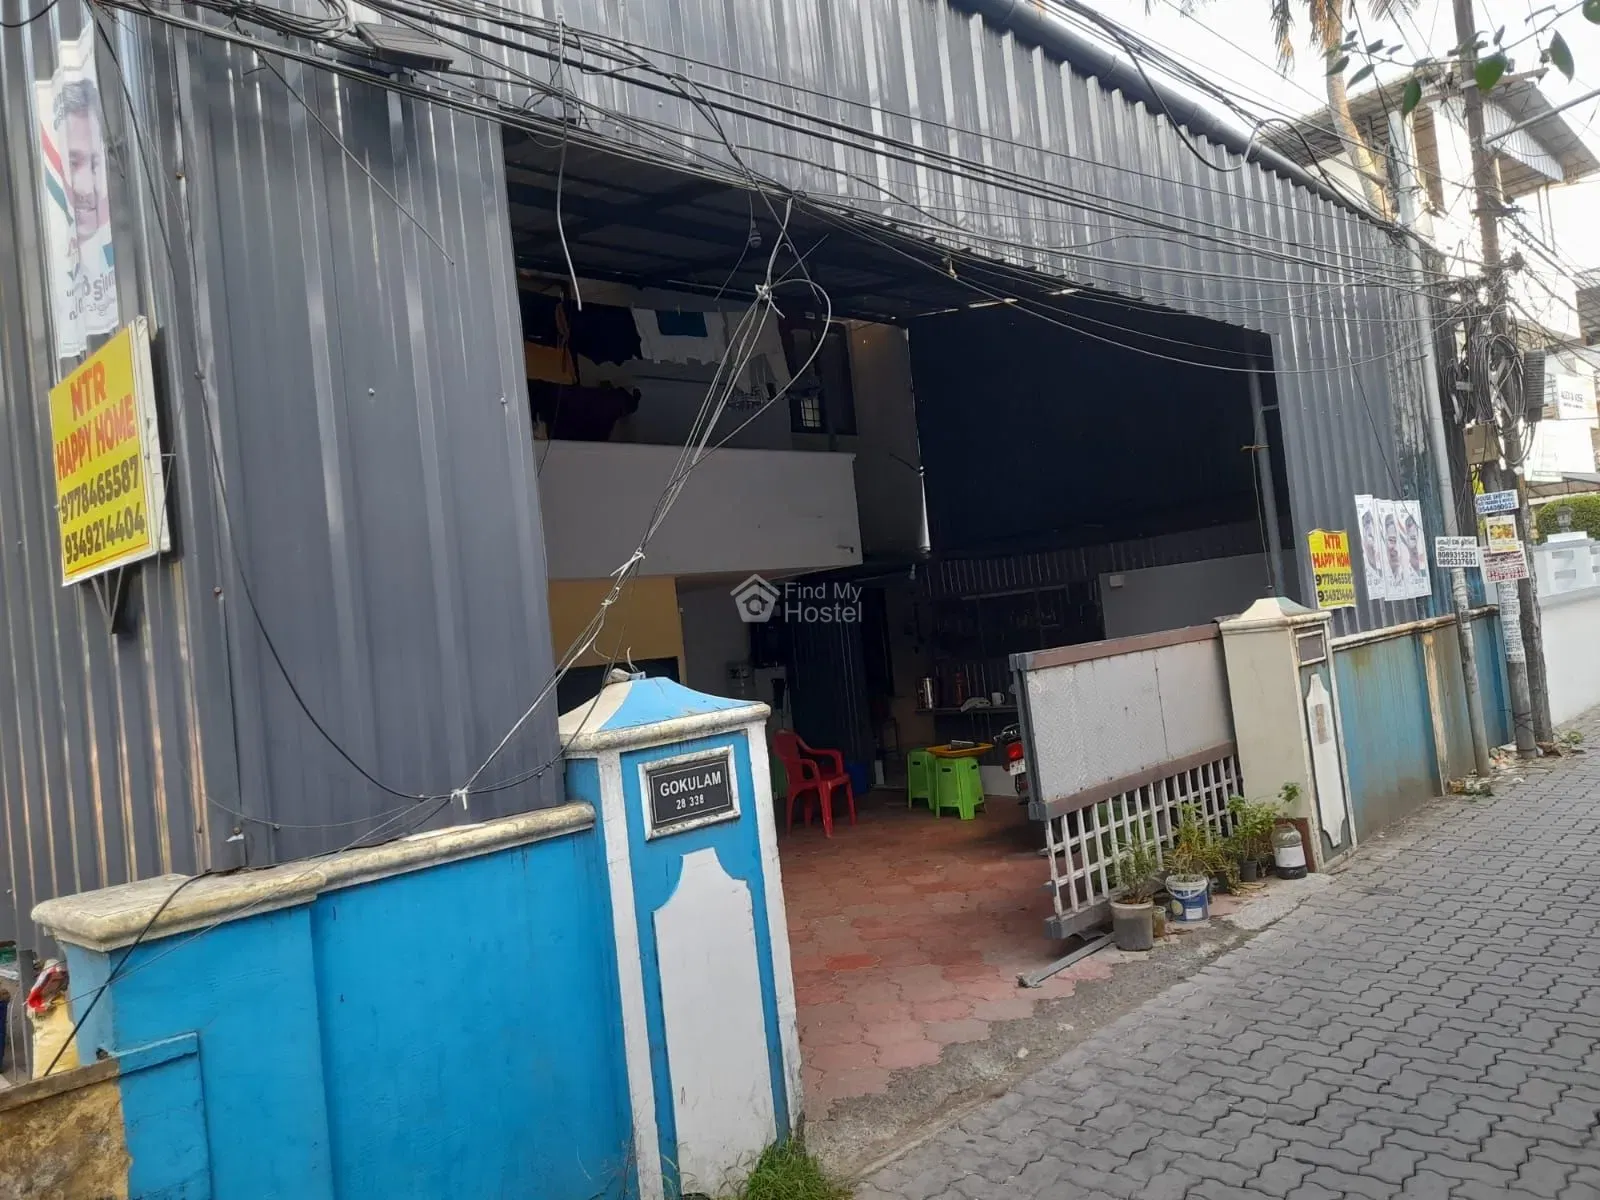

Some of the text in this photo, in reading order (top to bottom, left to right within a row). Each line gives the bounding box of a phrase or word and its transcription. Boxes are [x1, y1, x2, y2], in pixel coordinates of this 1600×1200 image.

[70, 360, 107, 421] NTR
[56, 393, 136, 480] HAPPY HOME
[61, 453, 139, 524] 9778465587
[65, 502, 145, 564] 9349214404
[1323, 534, 1342, 550] NTR
[660, 770, 722, 797] GOKULAM
[675, 798, 686, 810] 28
